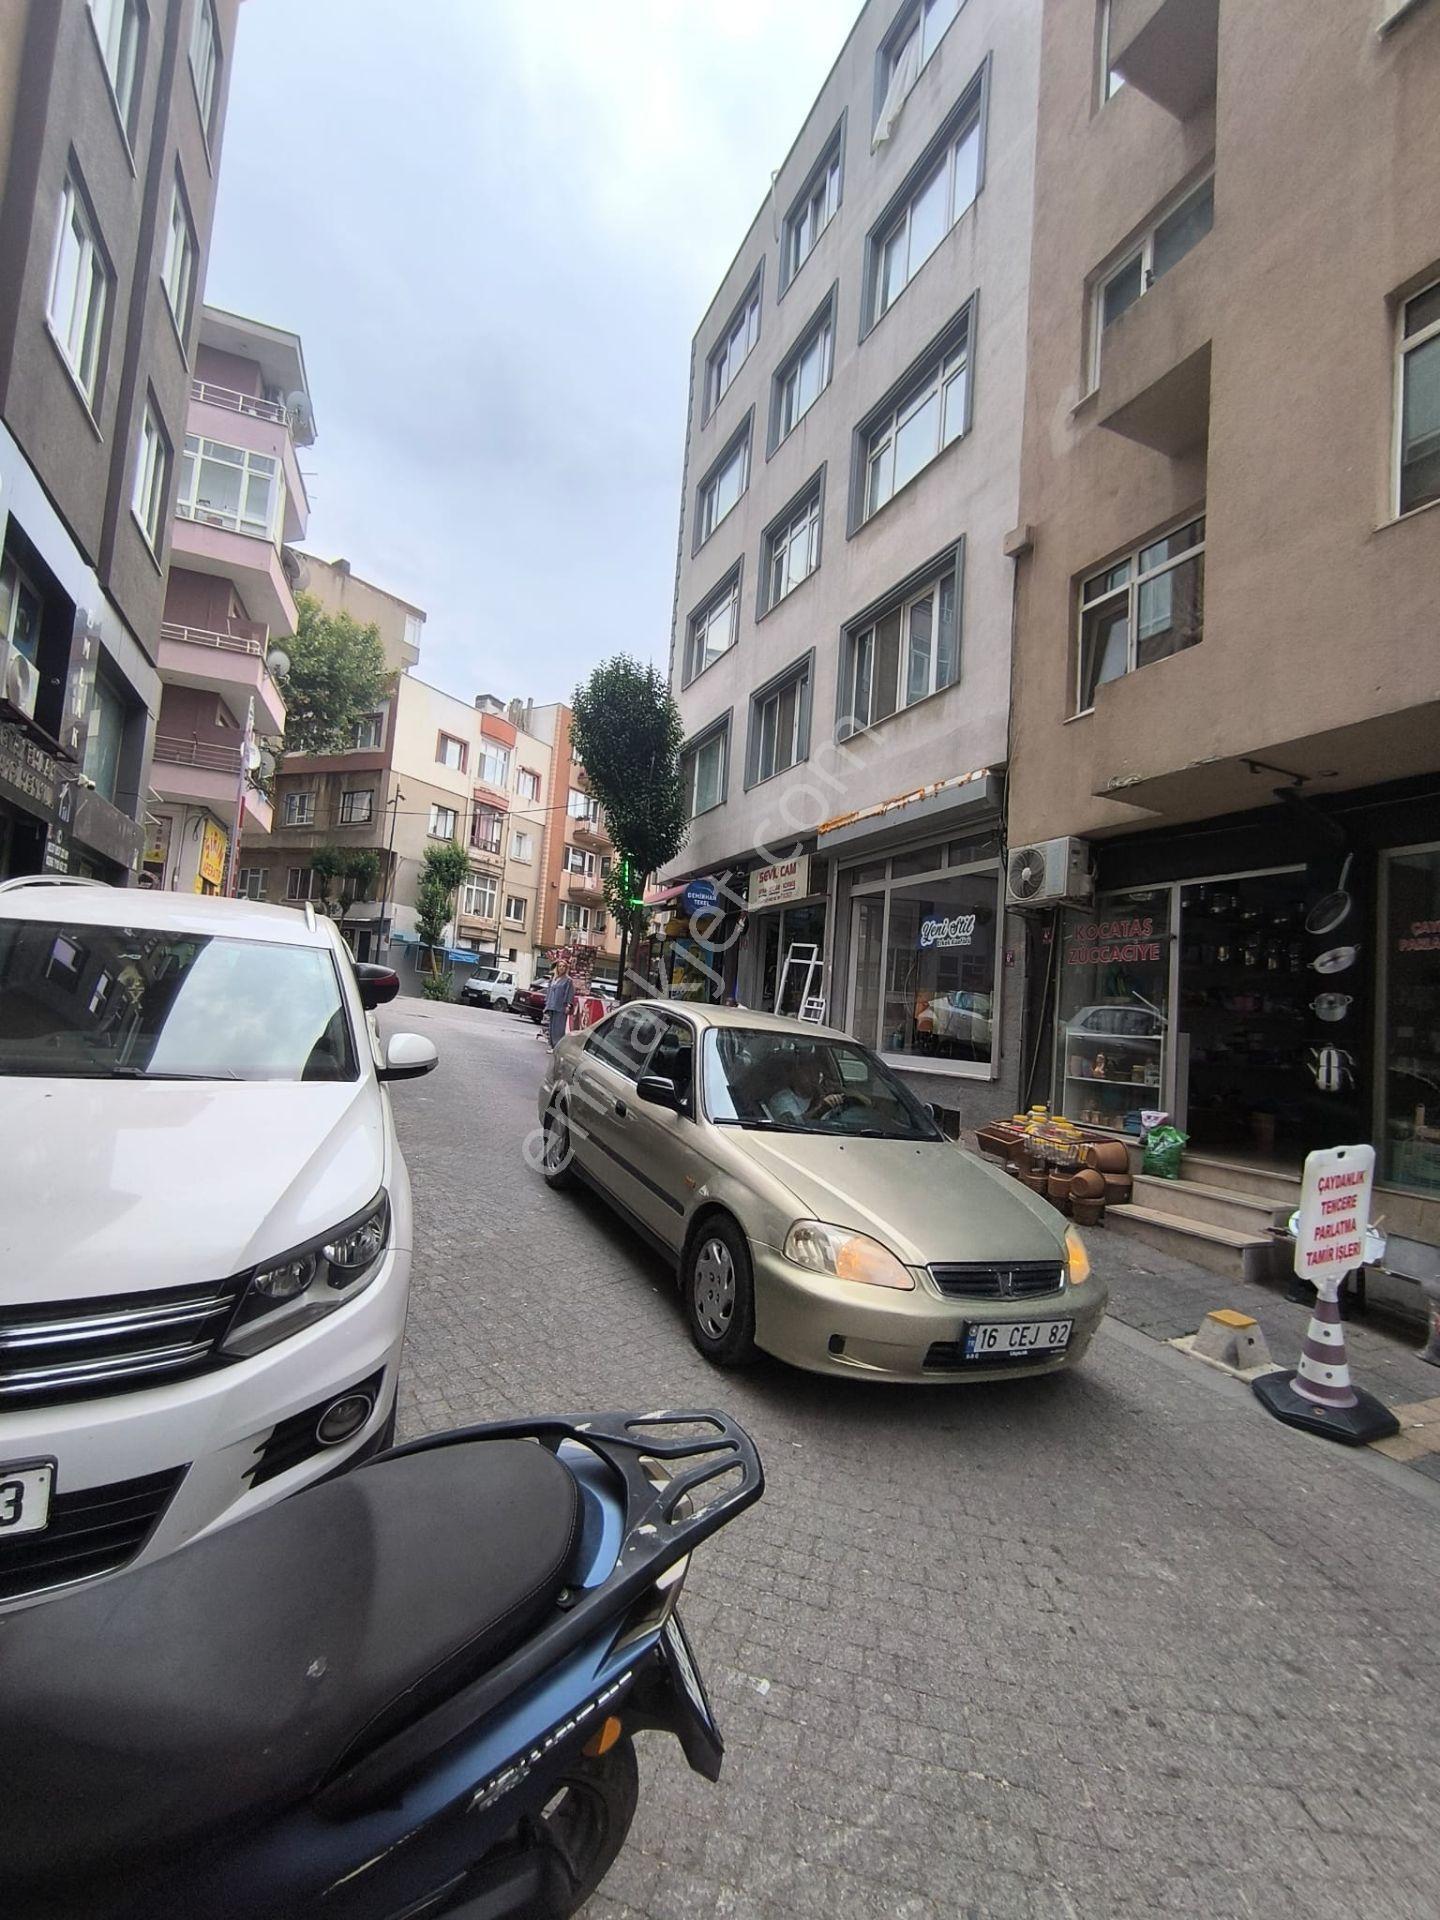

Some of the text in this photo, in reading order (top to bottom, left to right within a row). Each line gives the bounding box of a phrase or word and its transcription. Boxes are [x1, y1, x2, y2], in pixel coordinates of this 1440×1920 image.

[780, 862, 797, 877] CAM
[920, 918, 949, 946] Yeni
[1317, 1169, 1367, 1195] ÇAYDANLIK
[1321, 1194, 1358, 1216] TENCERE
[1314, 1218, 1358, 1241] PARLATMA
[1306, 1245, 1334, 1266] TAMİR
[981, 1324, 1068, 1349] 16 CEJ 82
[0, 1480, 25, 1527] 3
